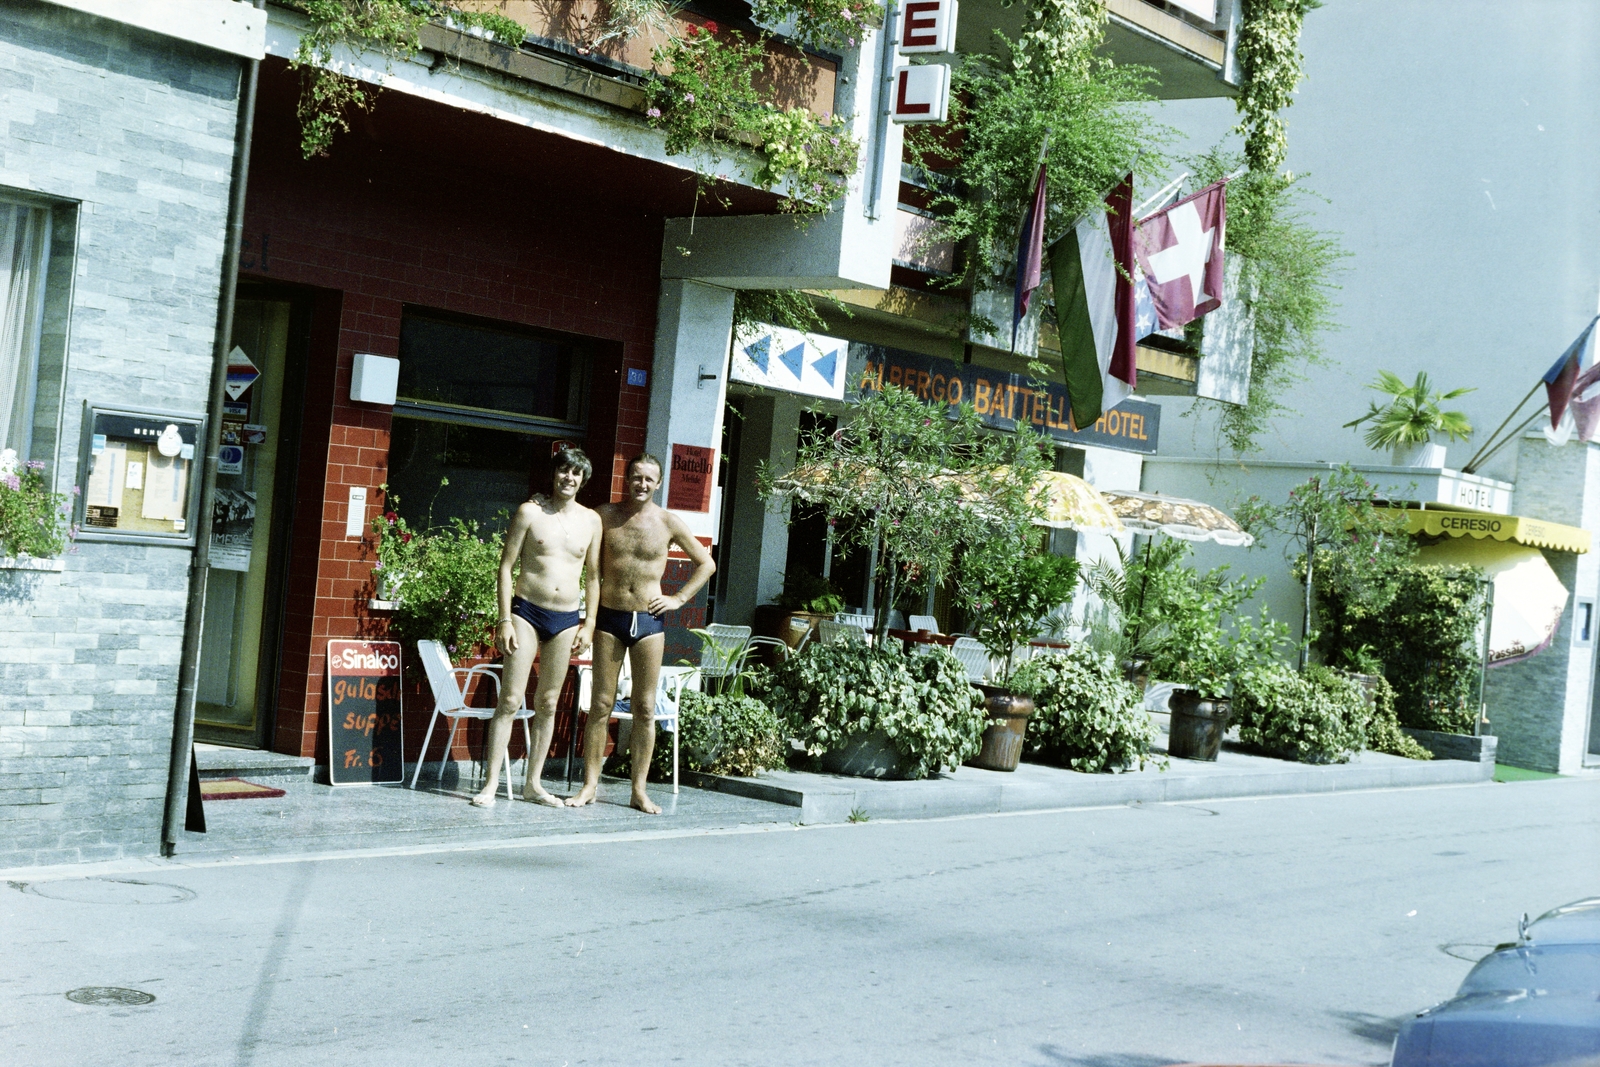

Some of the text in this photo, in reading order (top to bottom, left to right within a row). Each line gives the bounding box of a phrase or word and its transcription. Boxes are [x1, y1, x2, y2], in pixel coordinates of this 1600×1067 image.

[631, 371, 643, 383] 30
[134, 427, 163, 437] MENU
[1094, 409, 1148, 441] HOTEL
[671, 454, 713, 475] Battello
[1460, 487, 1492, 509] HOTEL
[1441, 516, 1502, 533] CERESIO
[342, 648, 398, 669] Sinalco
